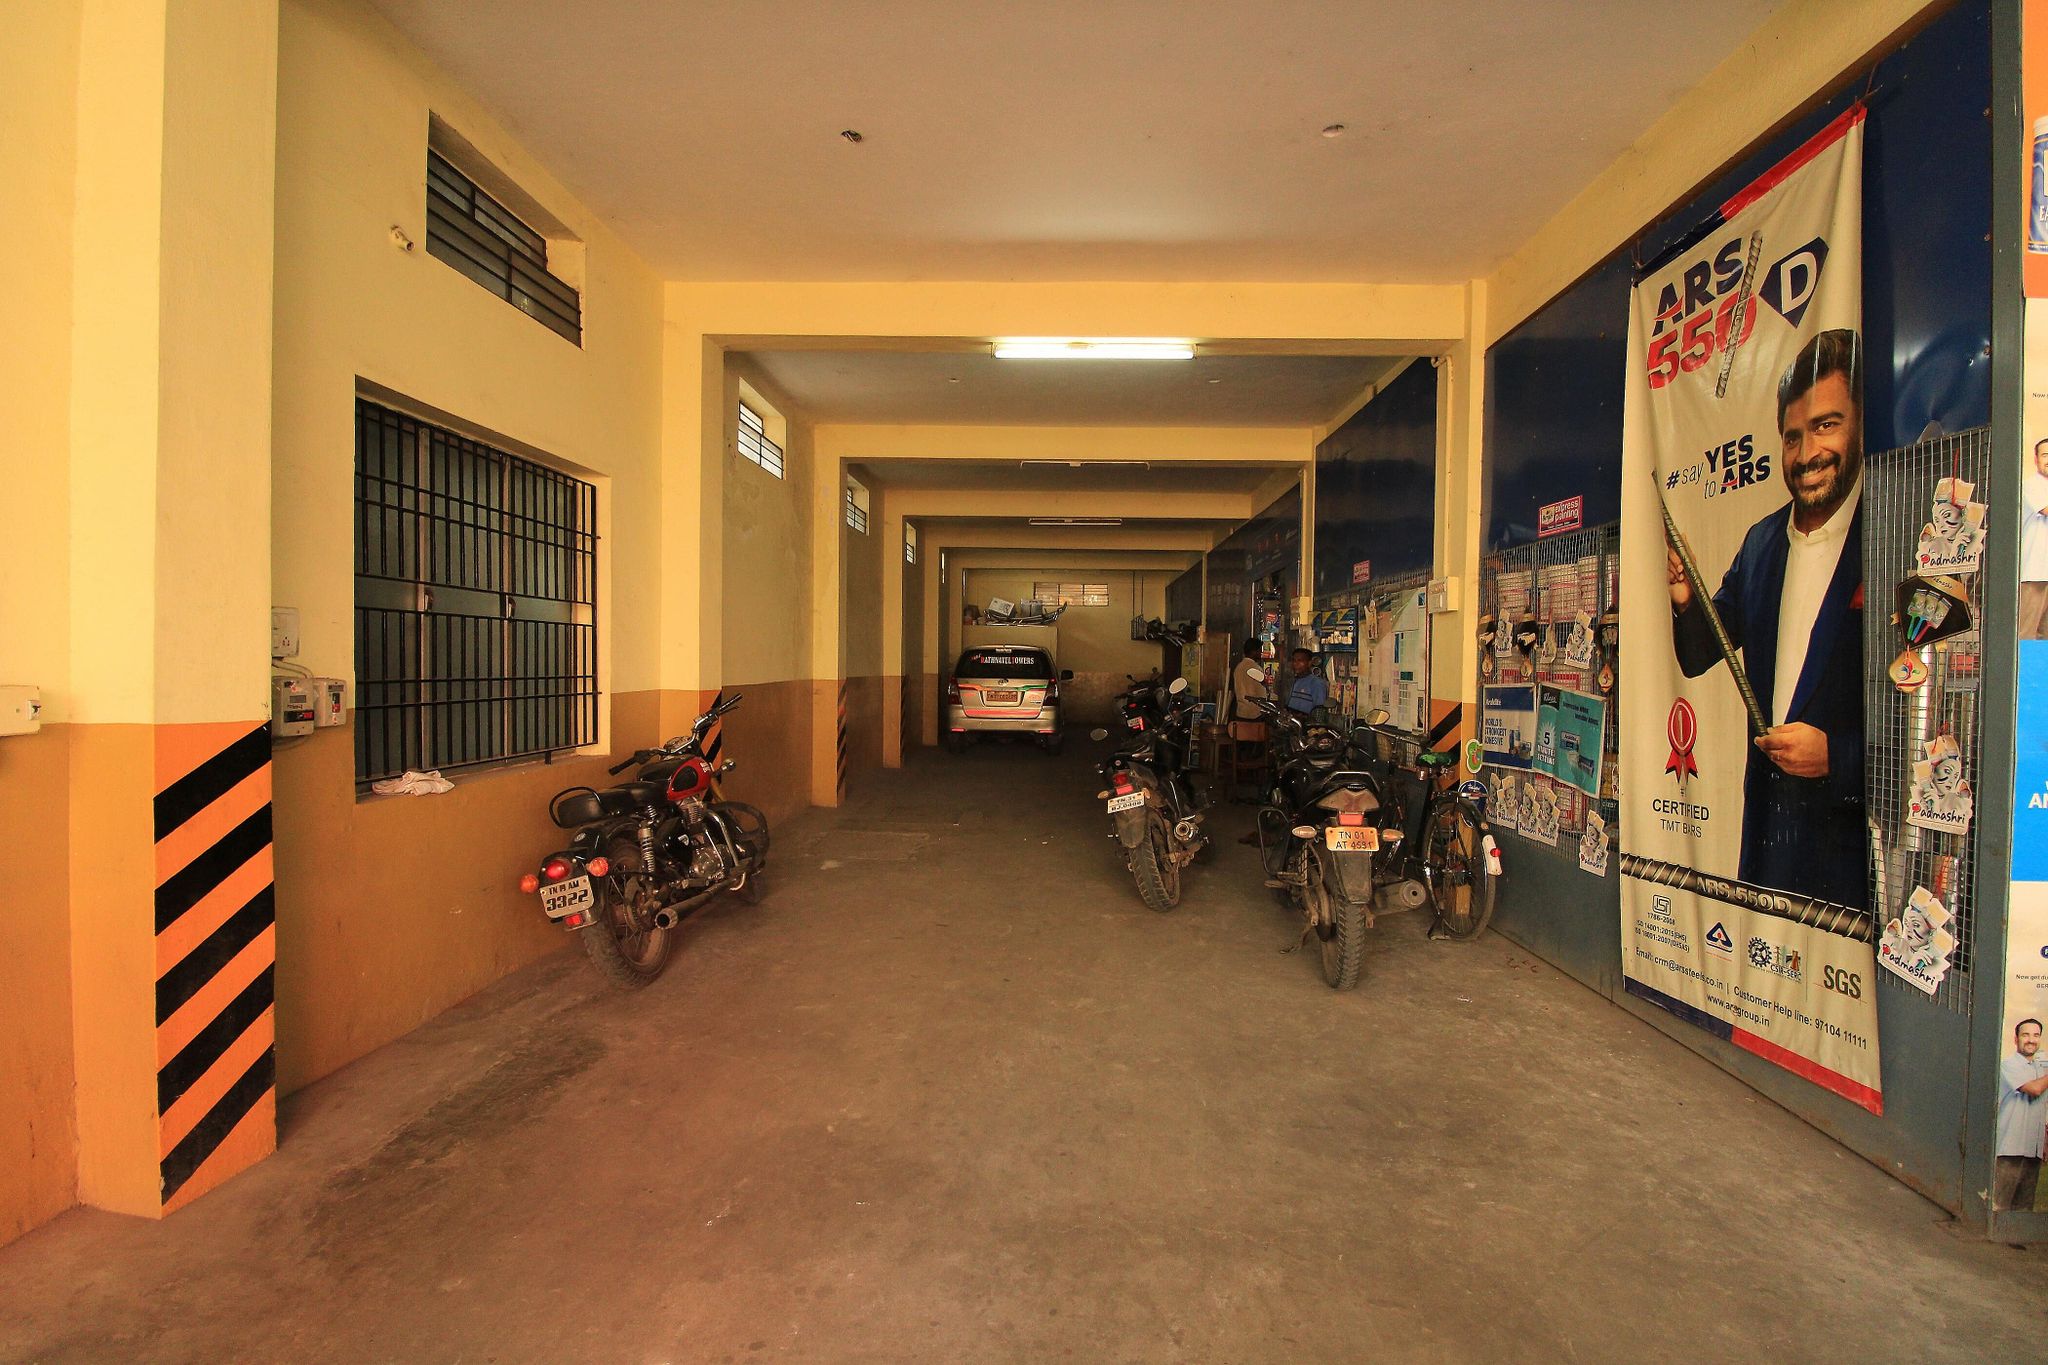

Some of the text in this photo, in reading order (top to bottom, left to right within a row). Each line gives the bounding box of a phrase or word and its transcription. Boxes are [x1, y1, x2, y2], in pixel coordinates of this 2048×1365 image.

[1652, 238, 1744, 337] ARS
[1780, 252, 1817, 315] D
[1647, 291, 1757, 389] 550
[1666, 435, 1753, 489] #say YES
[1704, 455, 1771, 499] to ARS
[1920, 551, 1976, 568] Padmashri
[1544, 732, 1551, 745] 5
[1652, 799, 1710, 820] CERTIFIED
[1912, 803, 1966, 824] Padmashri
[1339, 831, 1351, 839] TN
[1660, 819, 1681, 833] TMT
[1336, 841, 1347, 849] AT
[1696, 876, 1730, 898] ARS
[546, 889, 589, 912] 3322
[1882, 944, 1936, 985] Padmashri
[1824, 965, 1861, 999] SGS
[1733, 986, 1772, 1009] Customer
[1774, 1001, 1793, 1019] Help
[1794, 1009, 1812, 1026] line:
[1815, 1018, 1841, 1038] 97104
[1844, 1031, 1868, 1050] 11111
